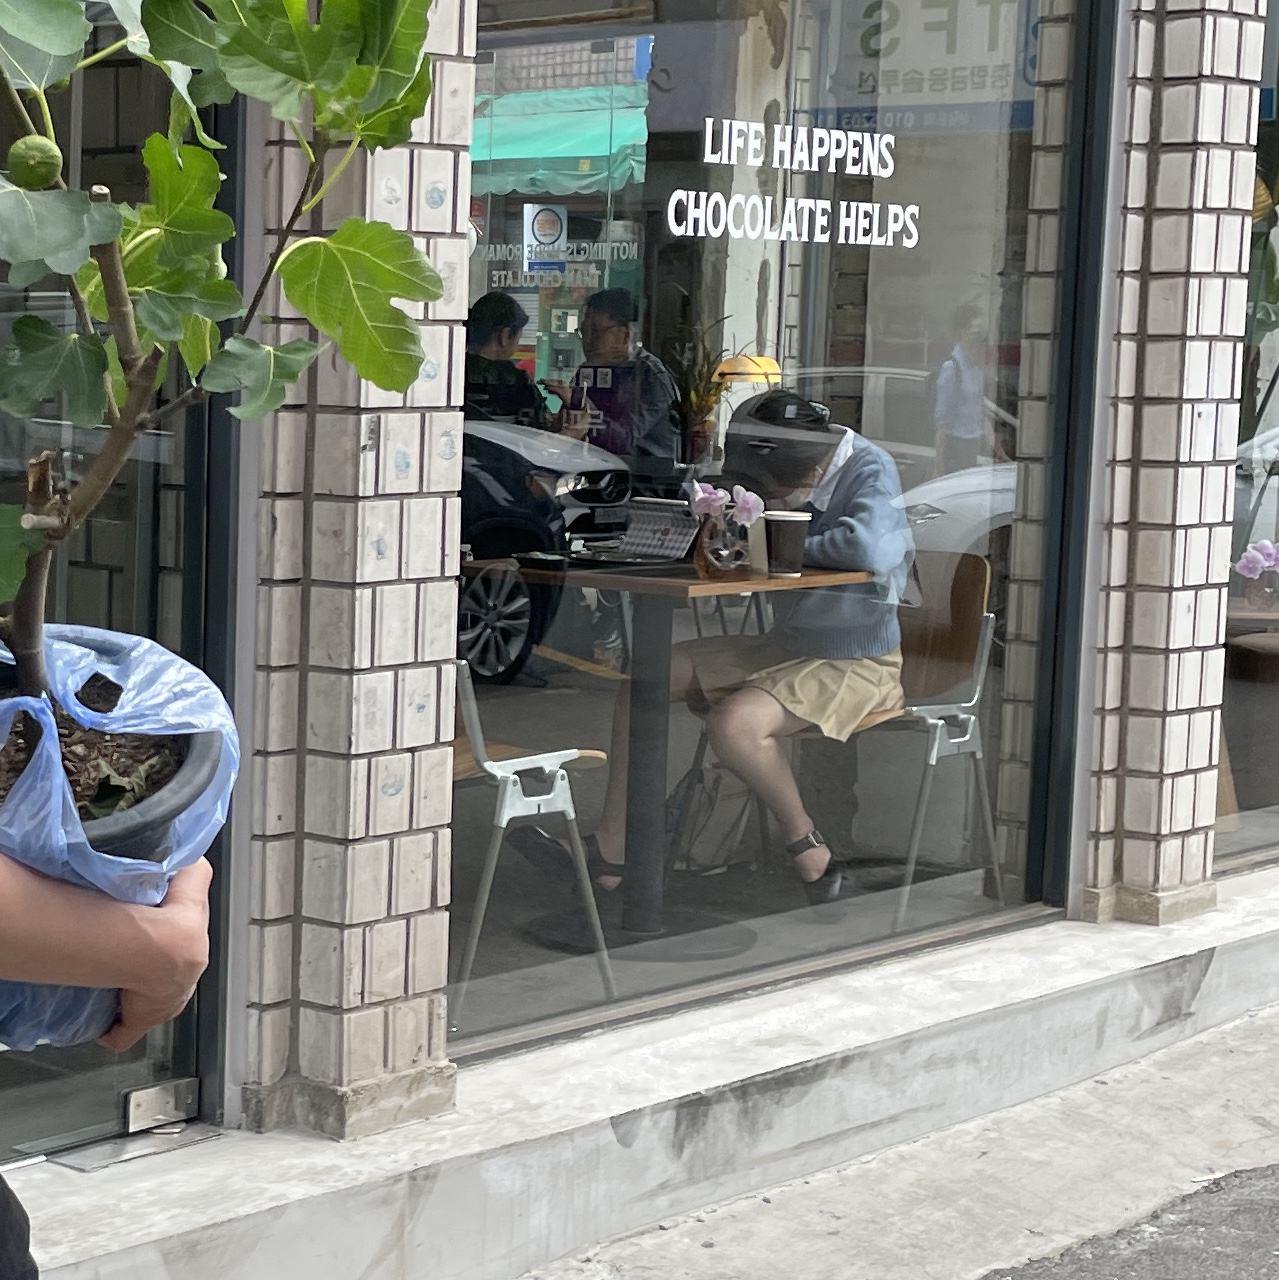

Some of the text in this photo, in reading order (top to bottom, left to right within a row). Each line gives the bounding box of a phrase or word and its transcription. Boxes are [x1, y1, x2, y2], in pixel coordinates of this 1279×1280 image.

[703, 117, 896, 178] LIFE HAPPENS
[667, 189, 920, 249] CHOCOLATE HELPS
